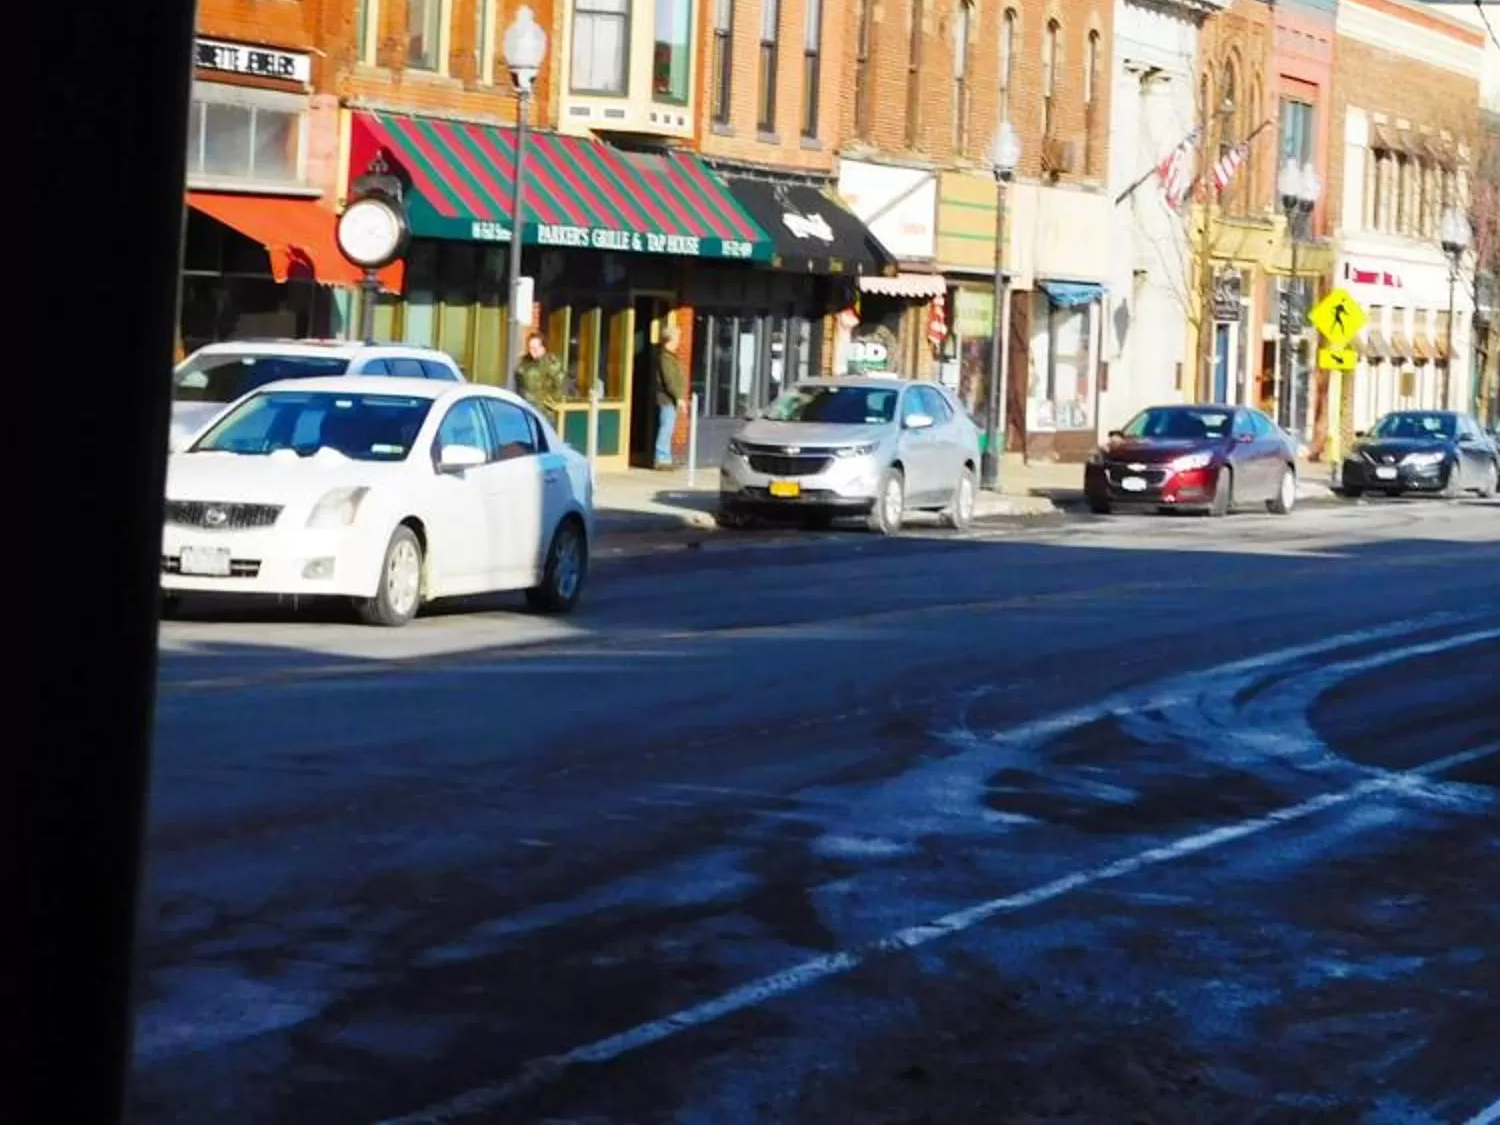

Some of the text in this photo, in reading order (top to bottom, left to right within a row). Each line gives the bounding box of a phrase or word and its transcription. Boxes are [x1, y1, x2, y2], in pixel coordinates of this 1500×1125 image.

[537, 224, 589, 247] PARKER'S
[592, 228, 630, 250] GRILLE
[667, 234, 700, 255] HOUSE
